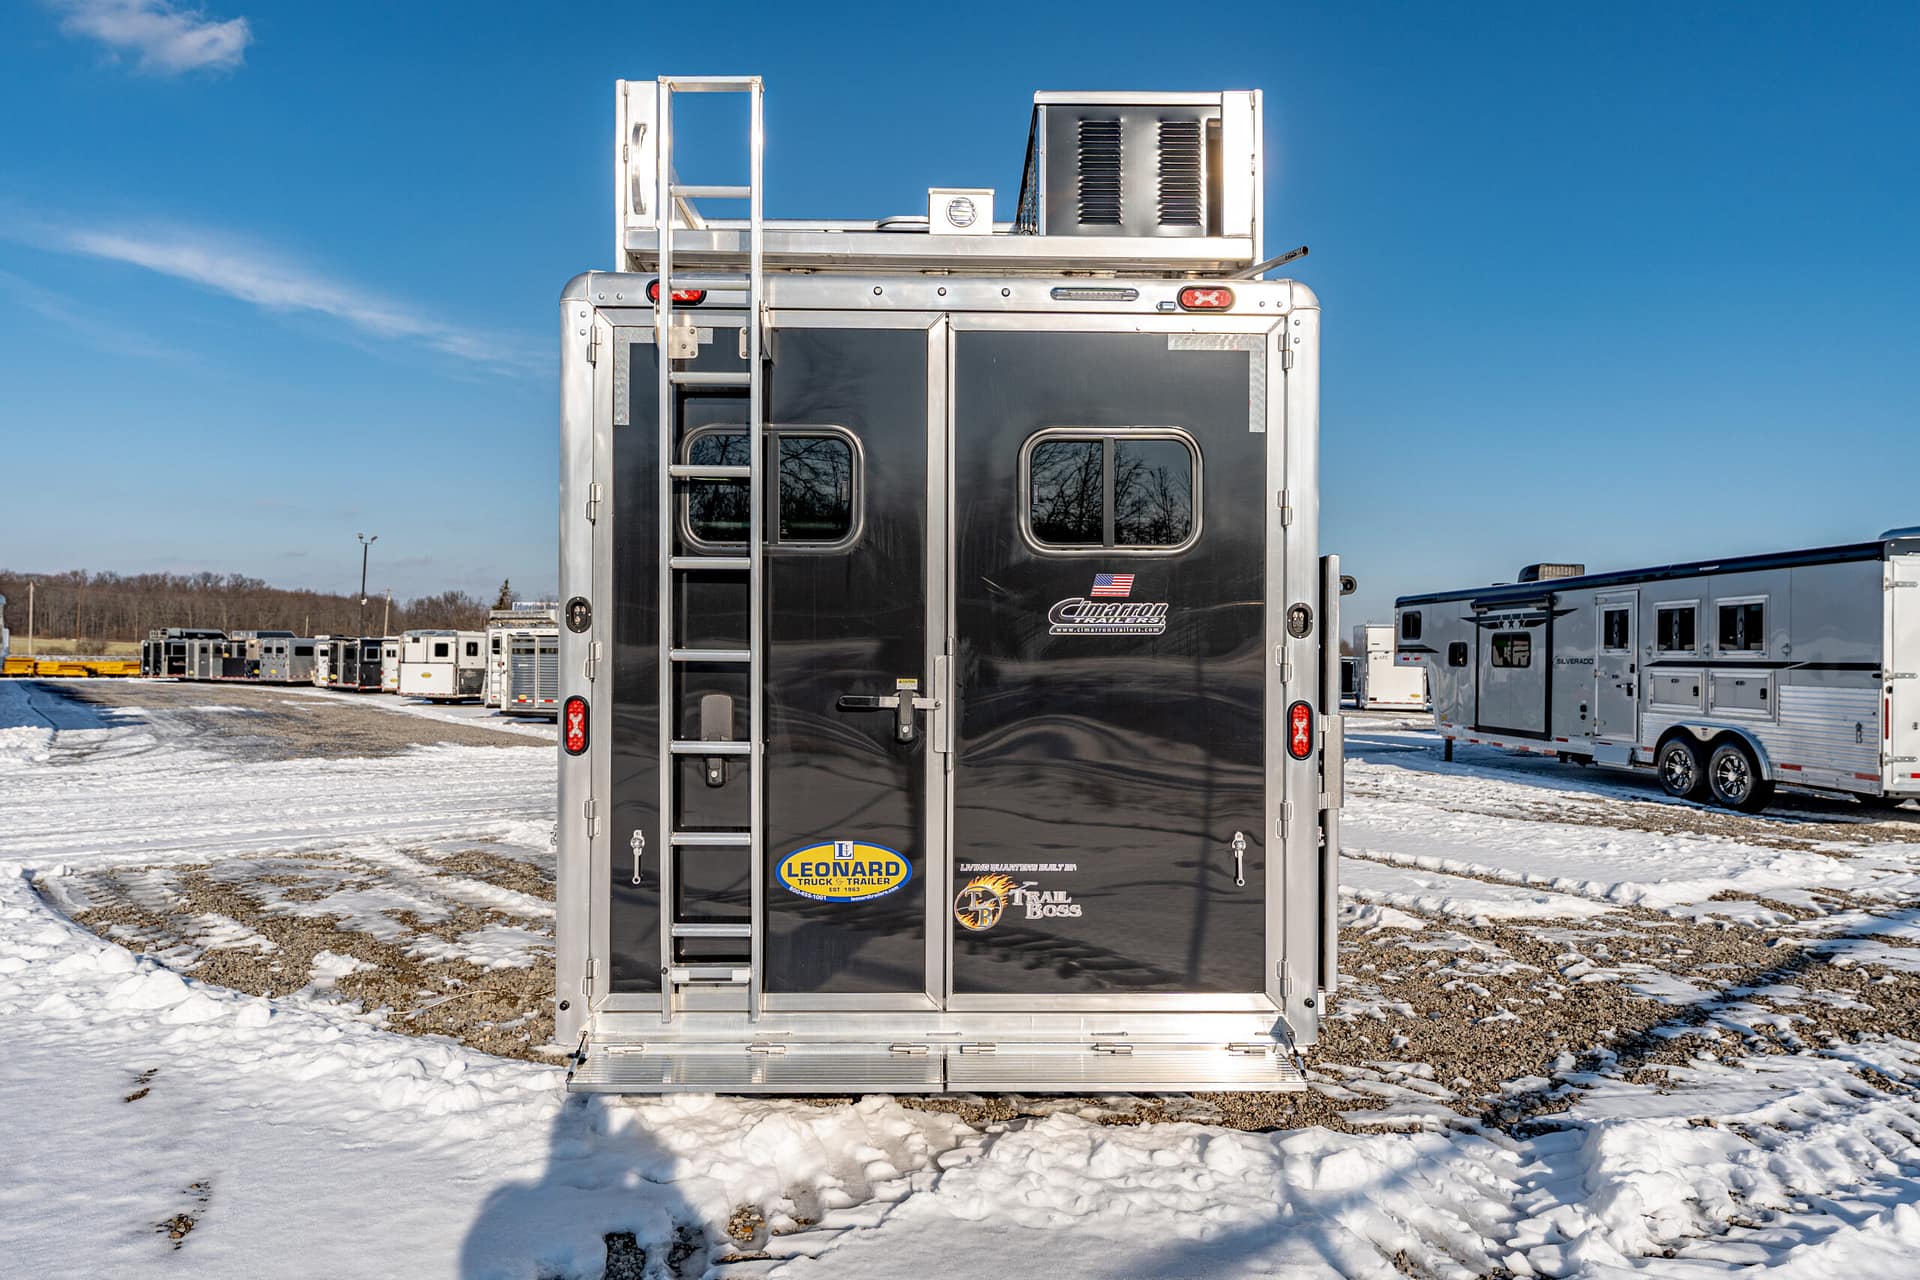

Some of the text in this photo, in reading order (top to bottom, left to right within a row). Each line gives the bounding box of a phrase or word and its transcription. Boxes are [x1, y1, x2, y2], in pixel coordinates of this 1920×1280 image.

[1048, 598, 1168, 625] Cimarron
[1073, 616, 1160, 624] TRAILERS
[787, 862, 900, 877] LEONARD
[990, 864, 1038, 872] QUARTERS
[797, 878, 832, 886] TRUCK
[847, 878, 890, 886] TRAILER
